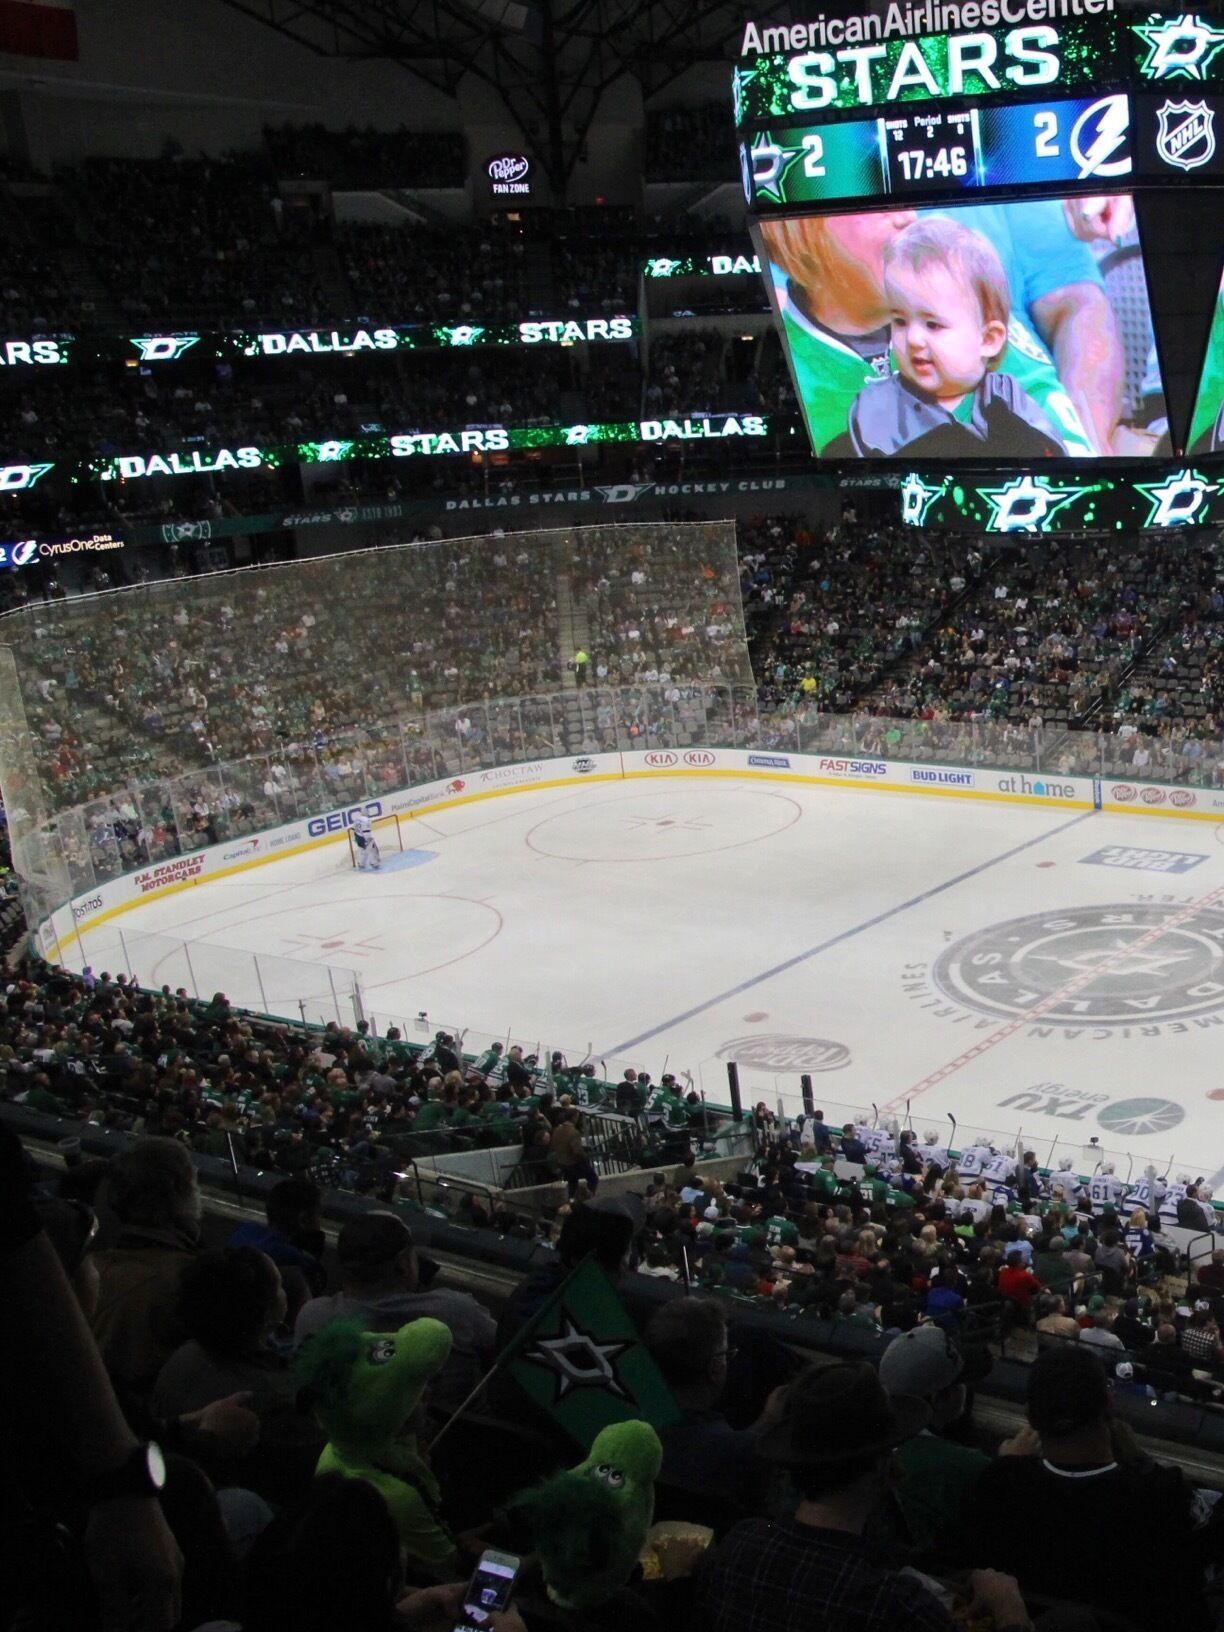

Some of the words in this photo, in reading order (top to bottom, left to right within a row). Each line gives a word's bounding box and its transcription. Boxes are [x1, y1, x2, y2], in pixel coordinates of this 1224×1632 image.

[788, 25, 1061, 111] STARS
[914, 114, 942, 127] Period
[893, 130, 904, 141] 12
[926, 126, 934, 139] 2
[1033, 111, 1060, 158] 2
[1170, 118, 1204, 155] NHL
[801, 134, 826, 178] 2
[897, 147, 968, 180] 17:46
[493, 183, 509, 193] FAN
[510, 183, 529, 193] ZONE
[0, 341, 62, 365] RS
[262, 329, 397, 355] DALLAS
[519, 318, 633, 344] STARS
[119, 446, 262, 478] DALLAS
[390, 429, 510, 457] STARS
[640, 416, 764, 441] DALLAS
[445, 494, 521, 511] DALLAS
[529, 490, 592, 505] STARS
[654, 482, 730, 496] HOCKEY
[738, 480, 786, 491] CLUB
[282, 513, 332, 526] STARS
[39, 538, 95, 557] CyrusOne
[93, 534, 112, 542] Data
[95, 540, 125, 551] Centers
[650, 754, 673, 764] KIA
[689, 753, 711, 763] KIA
[913, 770, 937, 782] BUD
[938, 772, 972, 785] LIGHT
[998, 777, 1020, 793] at
[153, 854, 206, 878] STANDLEY
[141, 865, 202, 893] MOTORCARS
[1027, 1081, 1110, 1102] energy
[996, 1092, 1097, 1121] TXU
[1092, 1184, 1109, 1200] 61
